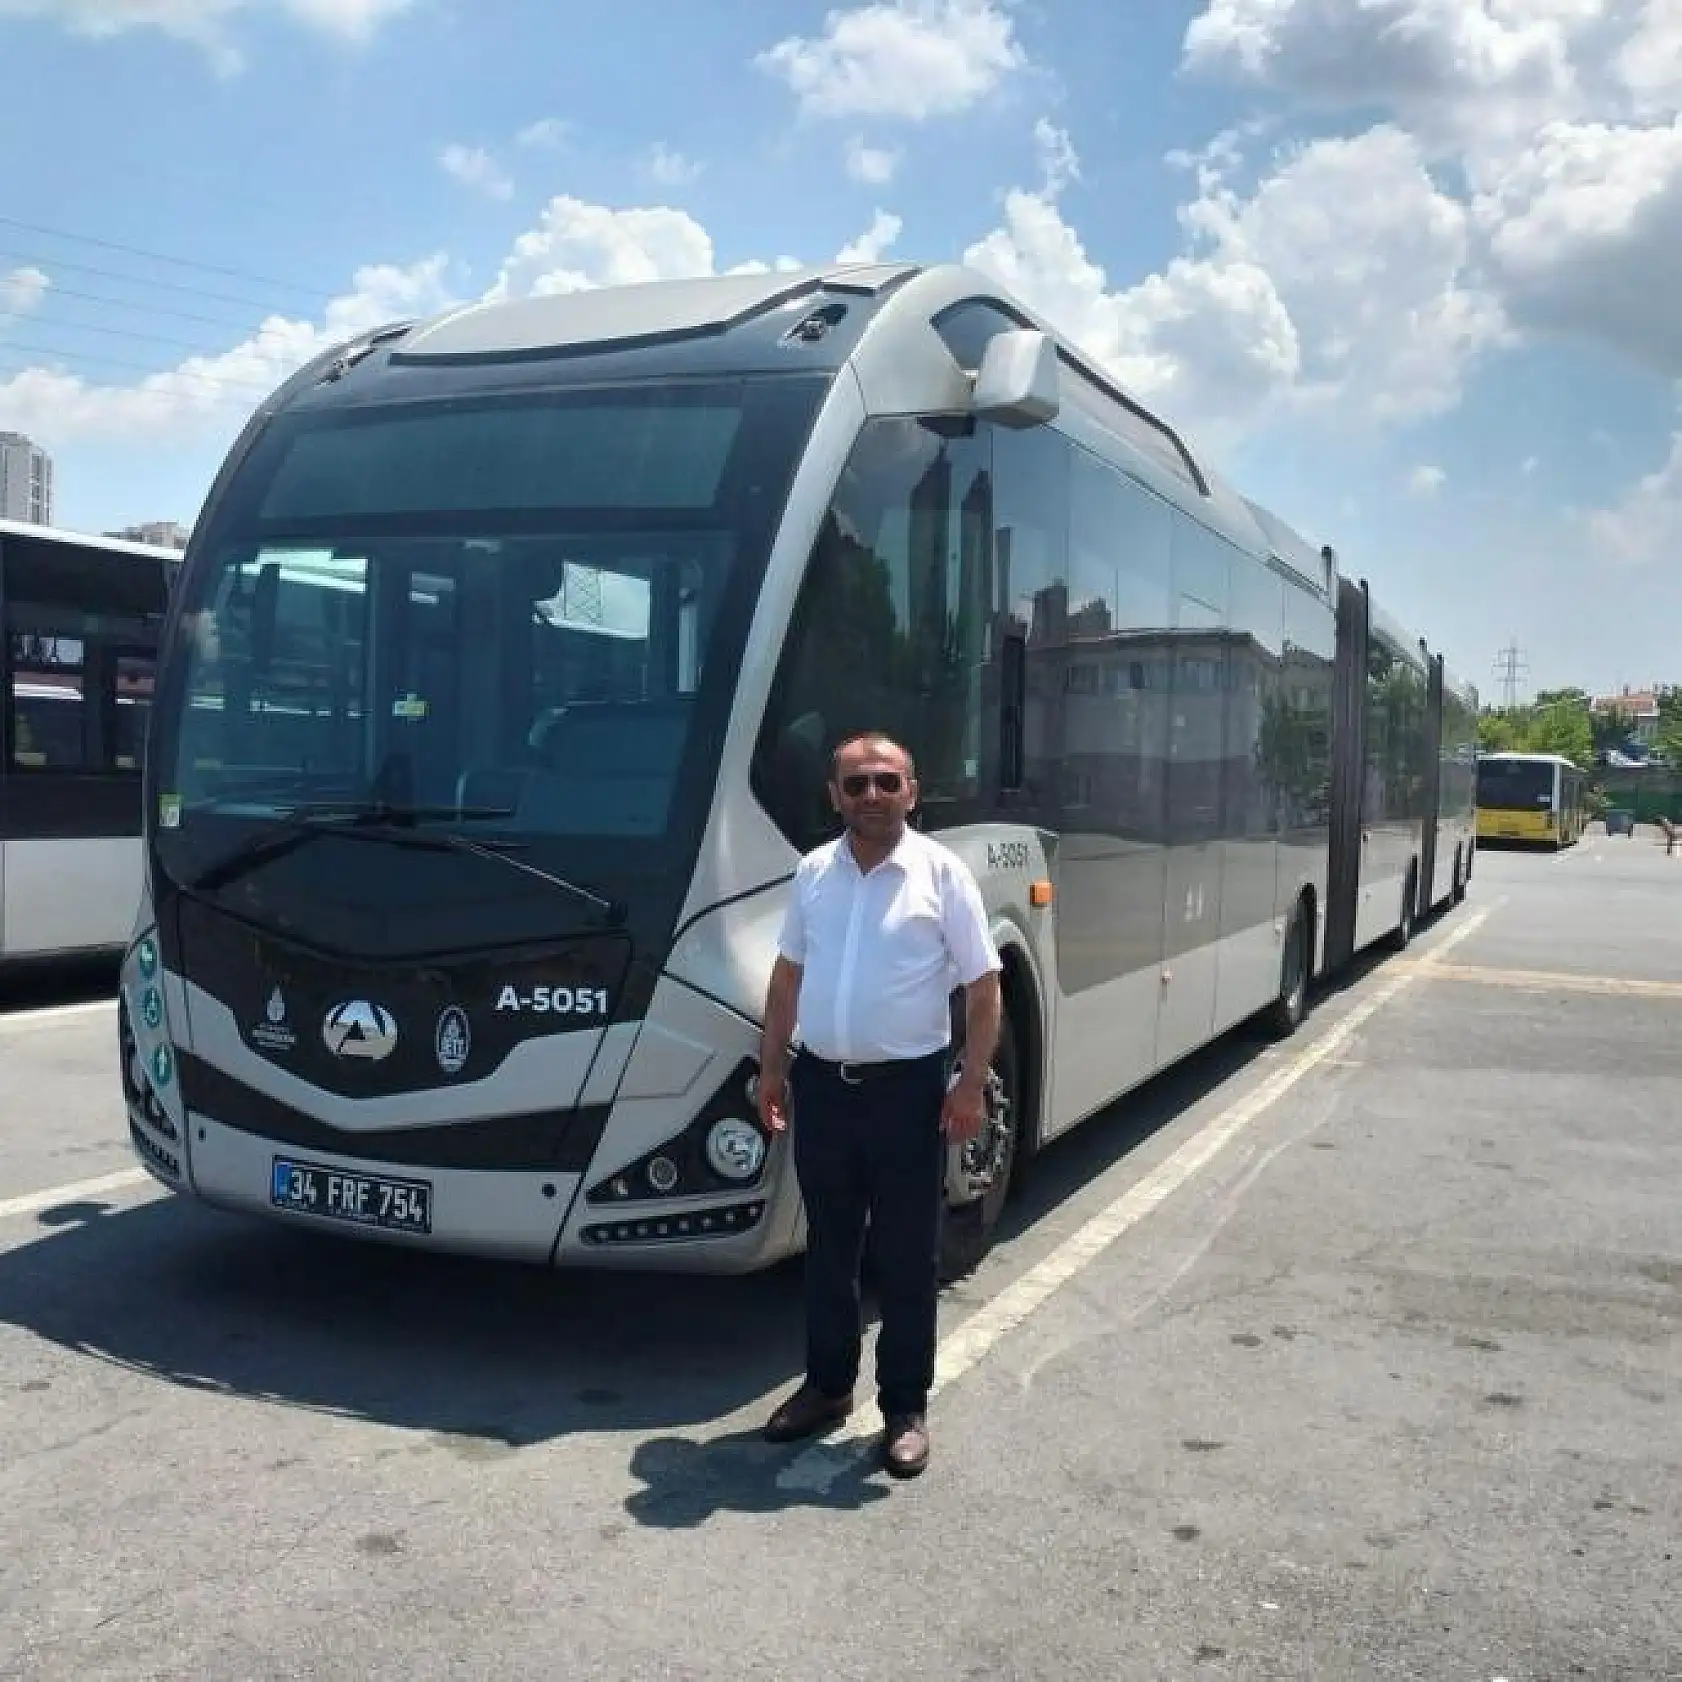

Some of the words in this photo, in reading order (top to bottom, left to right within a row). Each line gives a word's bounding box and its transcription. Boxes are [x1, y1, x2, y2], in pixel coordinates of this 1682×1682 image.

[495, 985, 608, 1014] A-5051
[291, 1169, 317, 1204] 34
[328, 1176, 371, 1213] FRF
[379, 1186, 423, 1222] 754
